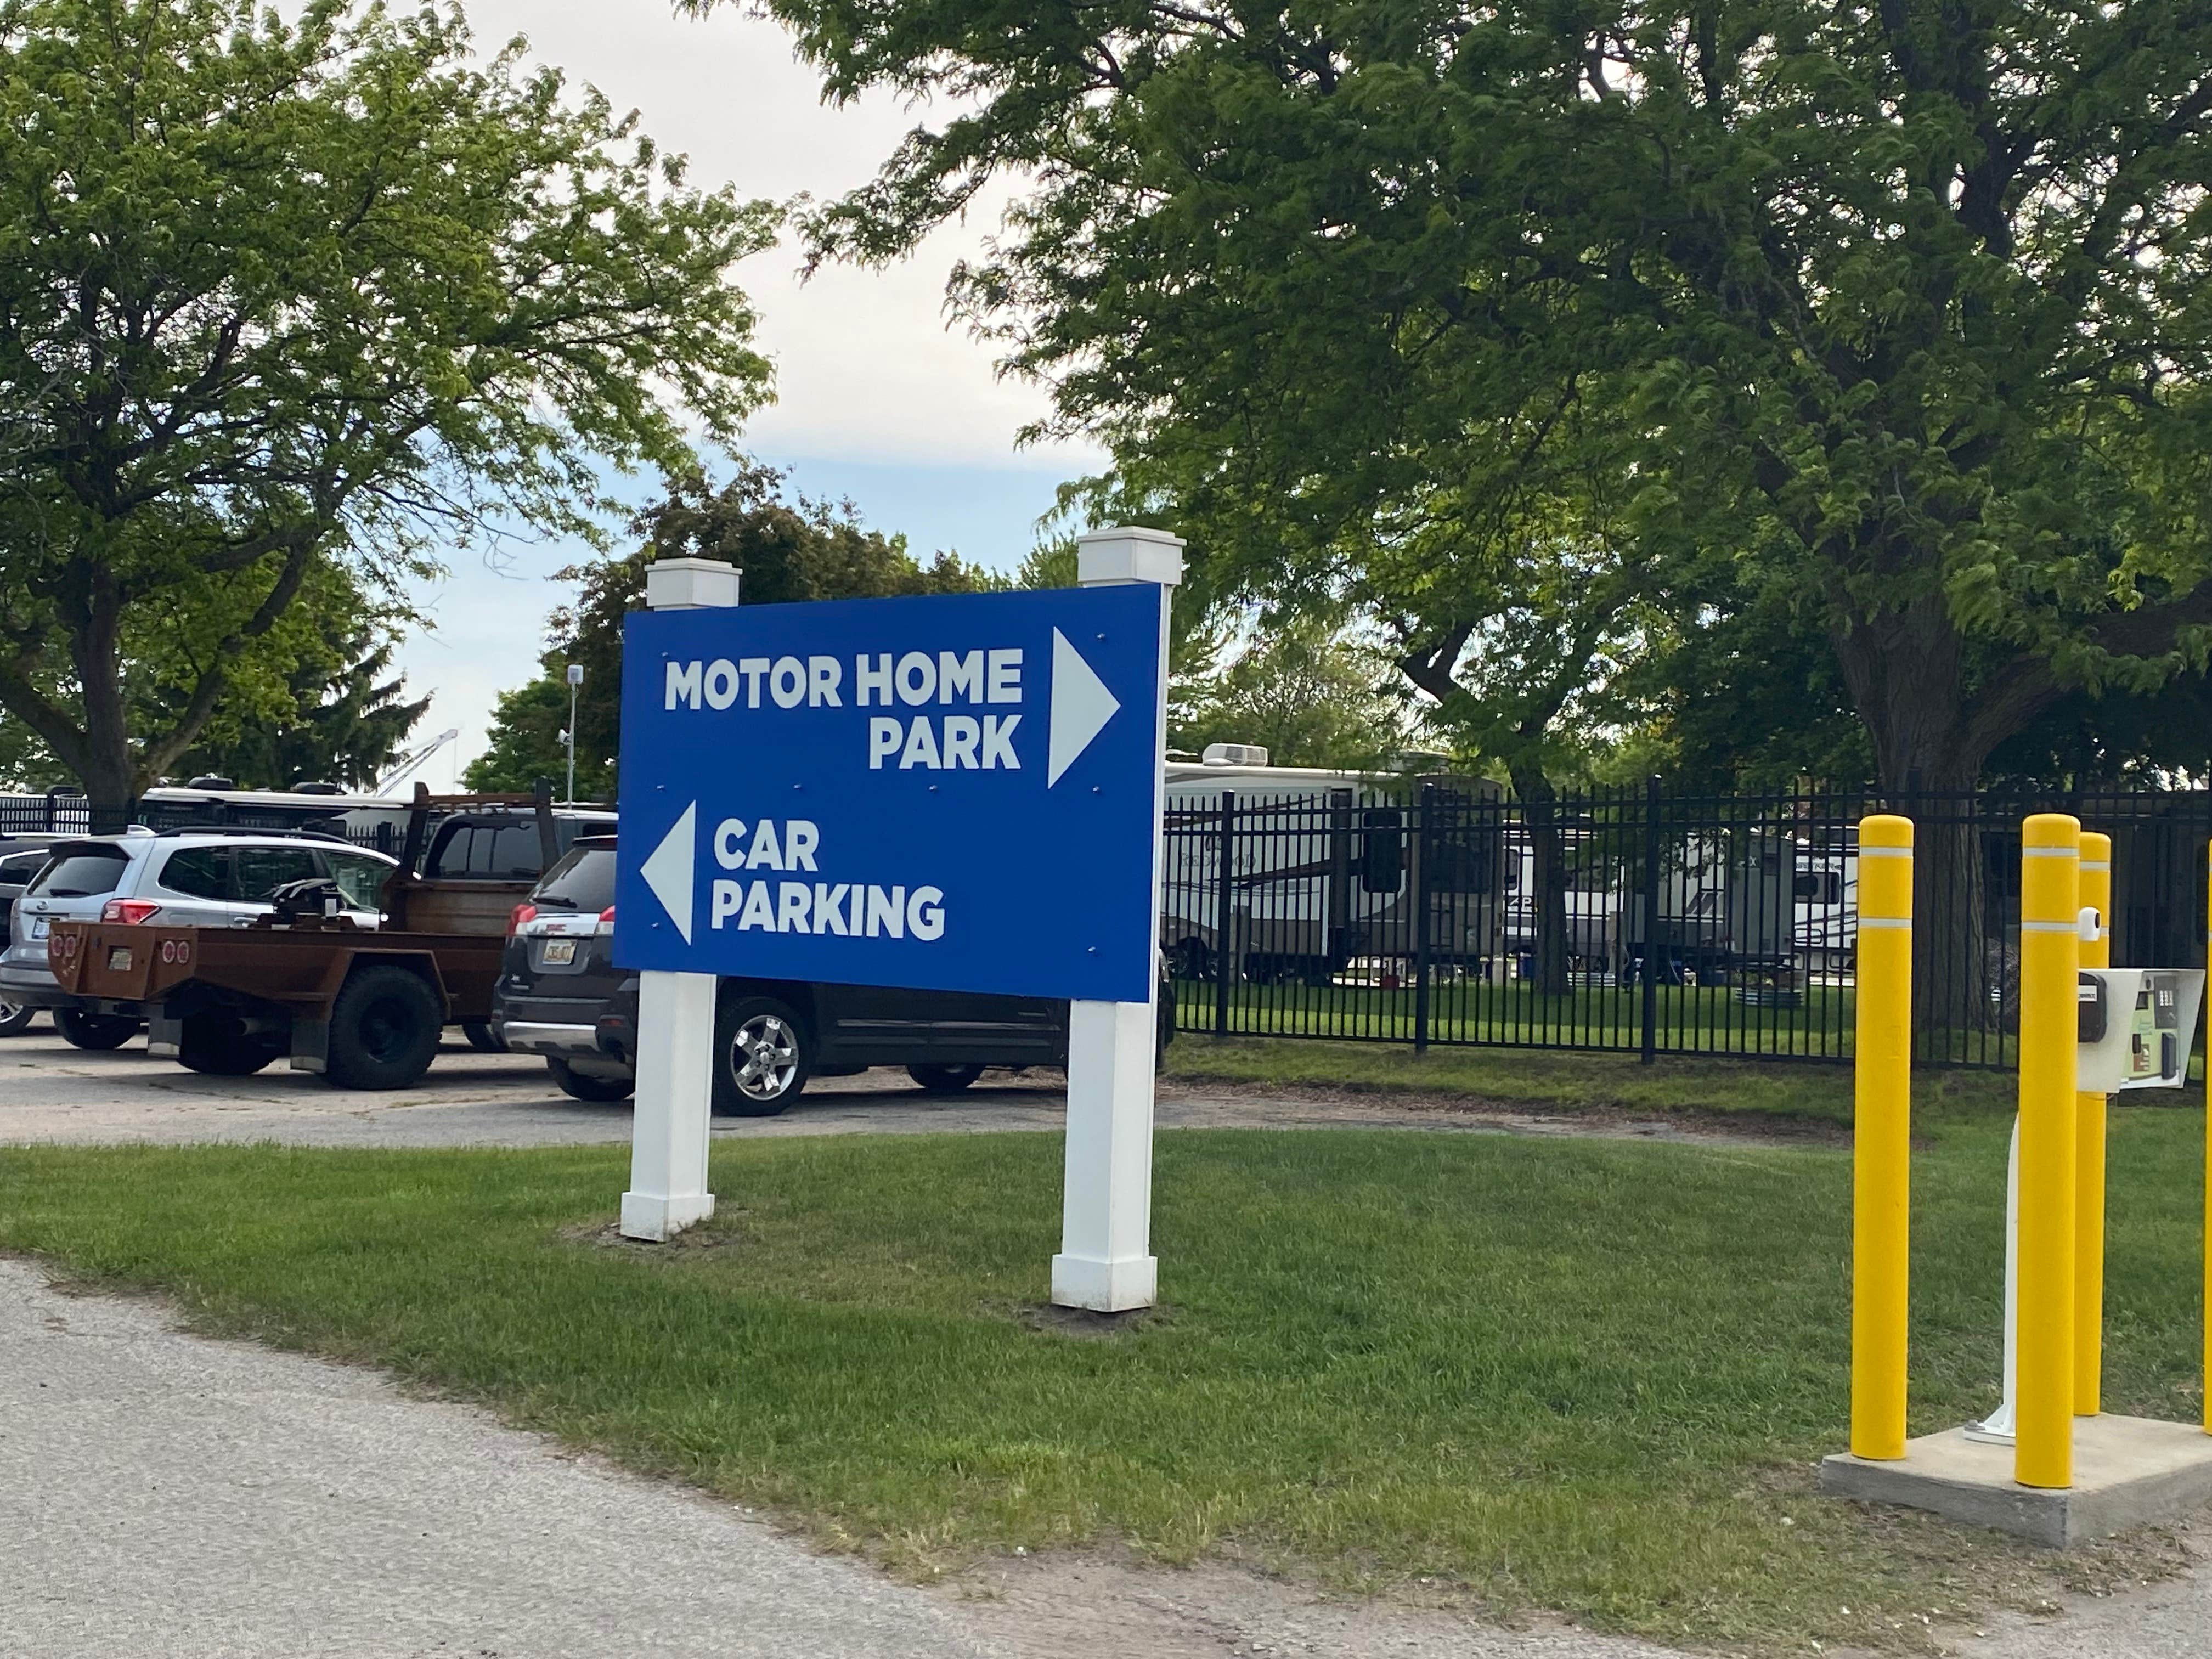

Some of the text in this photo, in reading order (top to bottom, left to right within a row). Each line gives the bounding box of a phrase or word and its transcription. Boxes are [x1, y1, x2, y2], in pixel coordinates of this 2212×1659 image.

[664, 648, 1023, 710] MOTOR HOME
[869, 715, 1023, 770] PARK
[714, 817, 820, 872] CAR
[1182, 852, 1256, 868] REDOD
[710, 879, 945, 941] PARKING
